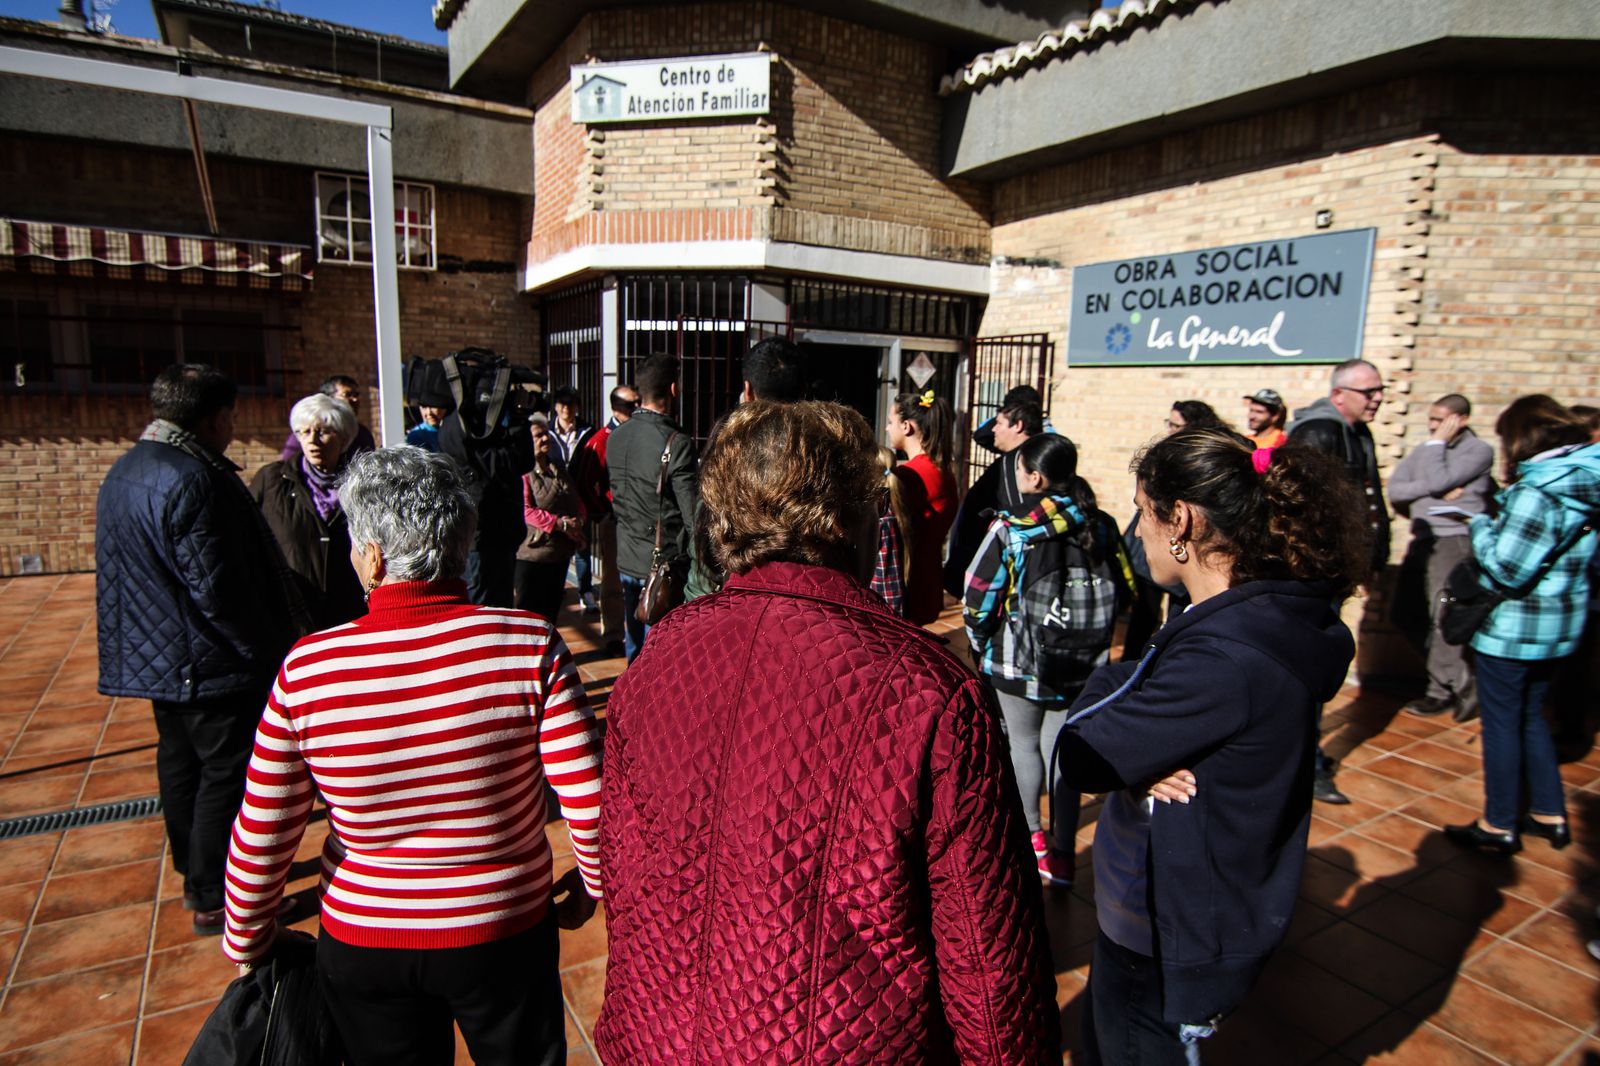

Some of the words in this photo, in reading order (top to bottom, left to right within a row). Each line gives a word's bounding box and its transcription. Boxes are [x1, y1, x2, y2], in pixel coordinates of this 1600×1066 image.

[660, 66, 711, 87] Centro
[718, 63, 735, 83] de
[701, 87, 767, 111] Familiar
[1114, 257, 1177, 285] OBRA
[1196, 242, 1298, 276] SOCIAL
[1085, 294, 1110, 315] EN
[1122, 272, 1343, 312] COLABORACION
[1147, 317, 1175, 350] La
[1178, 310, 1303, 362] General
